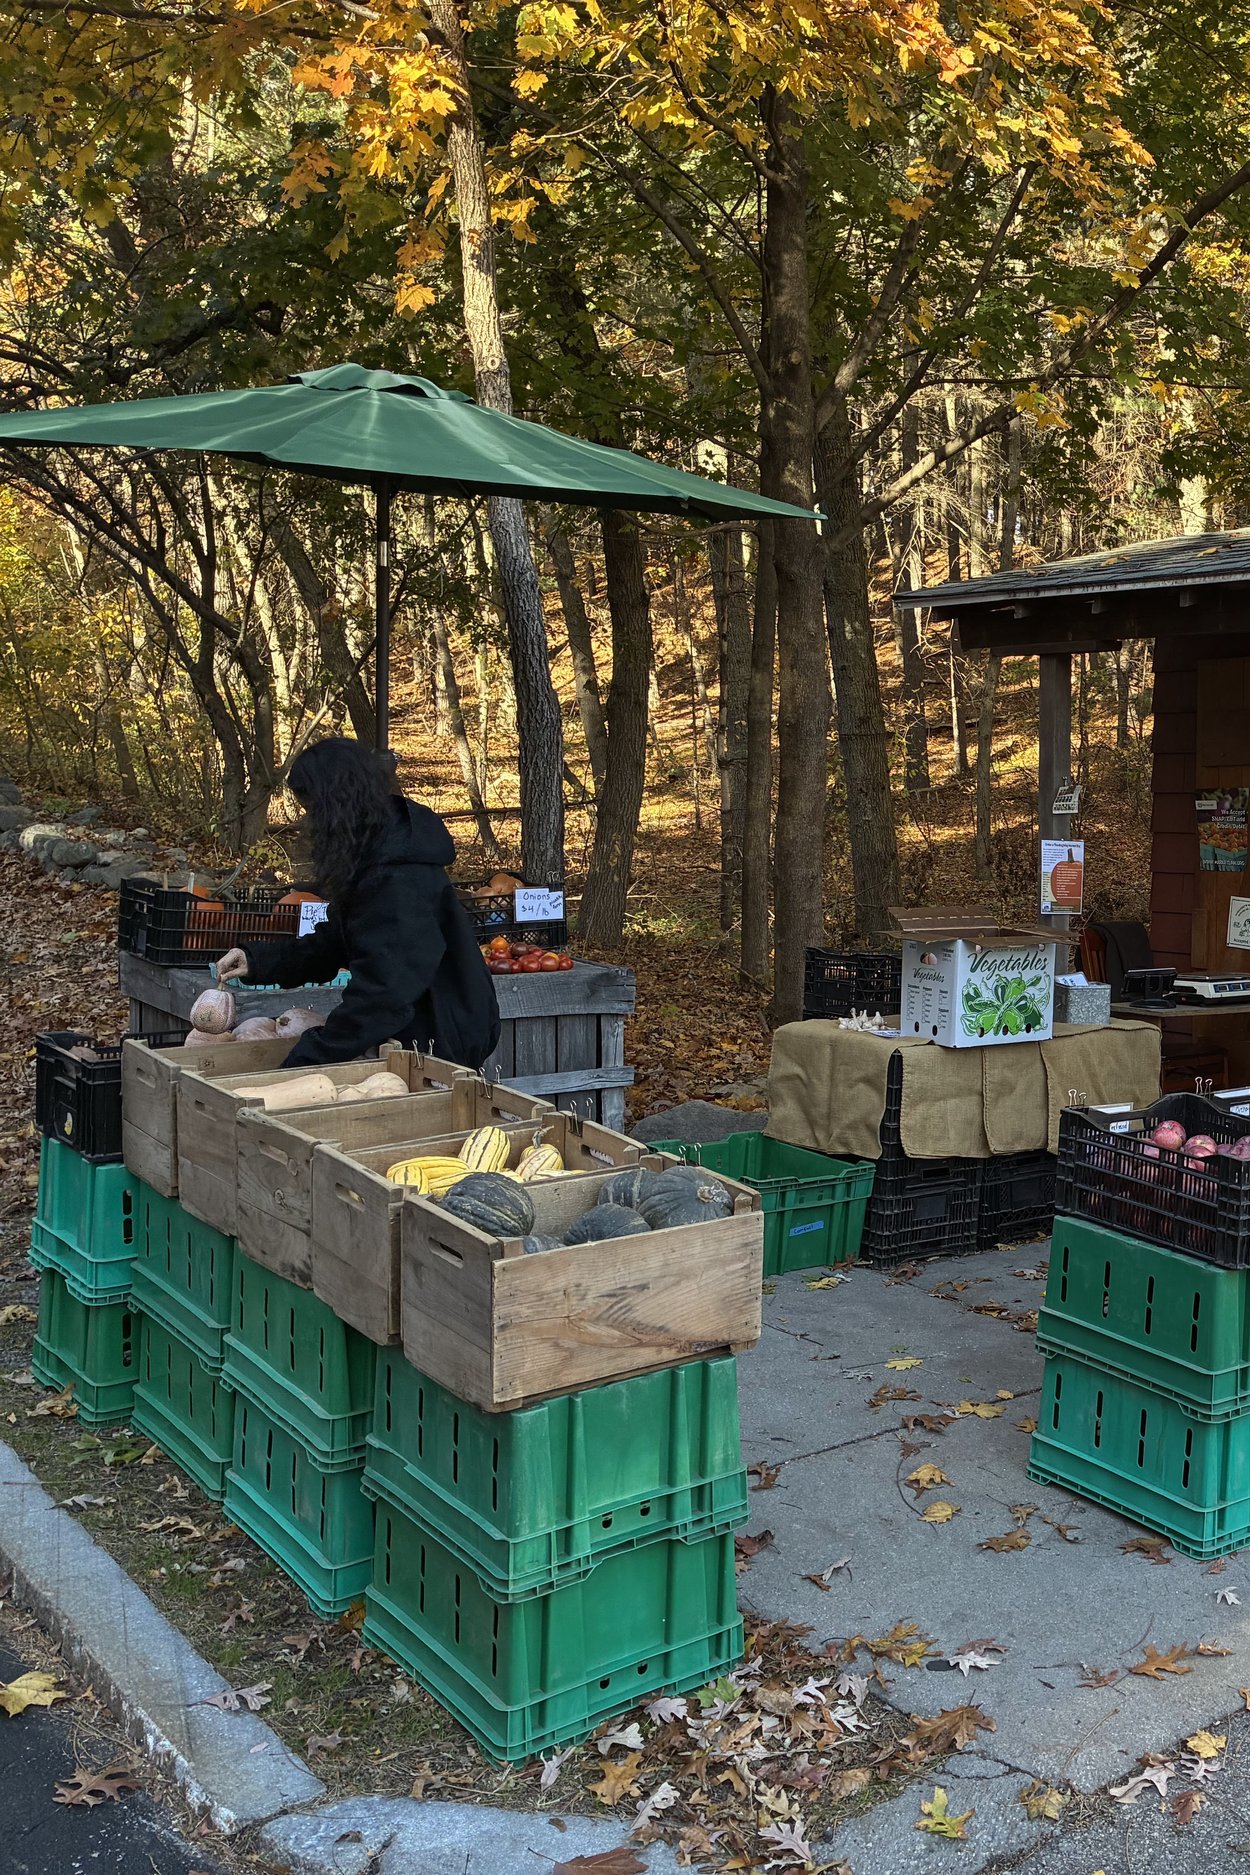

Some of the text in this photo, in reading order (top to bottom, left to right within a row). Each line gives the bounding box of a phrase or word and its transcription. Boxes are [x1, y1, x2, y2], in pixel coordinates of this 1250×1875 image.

[522, 891, 551, 901] Onions
[968, 949, 1048, 981] Vegetables
[912, 967, 945, 983] Vegetables
